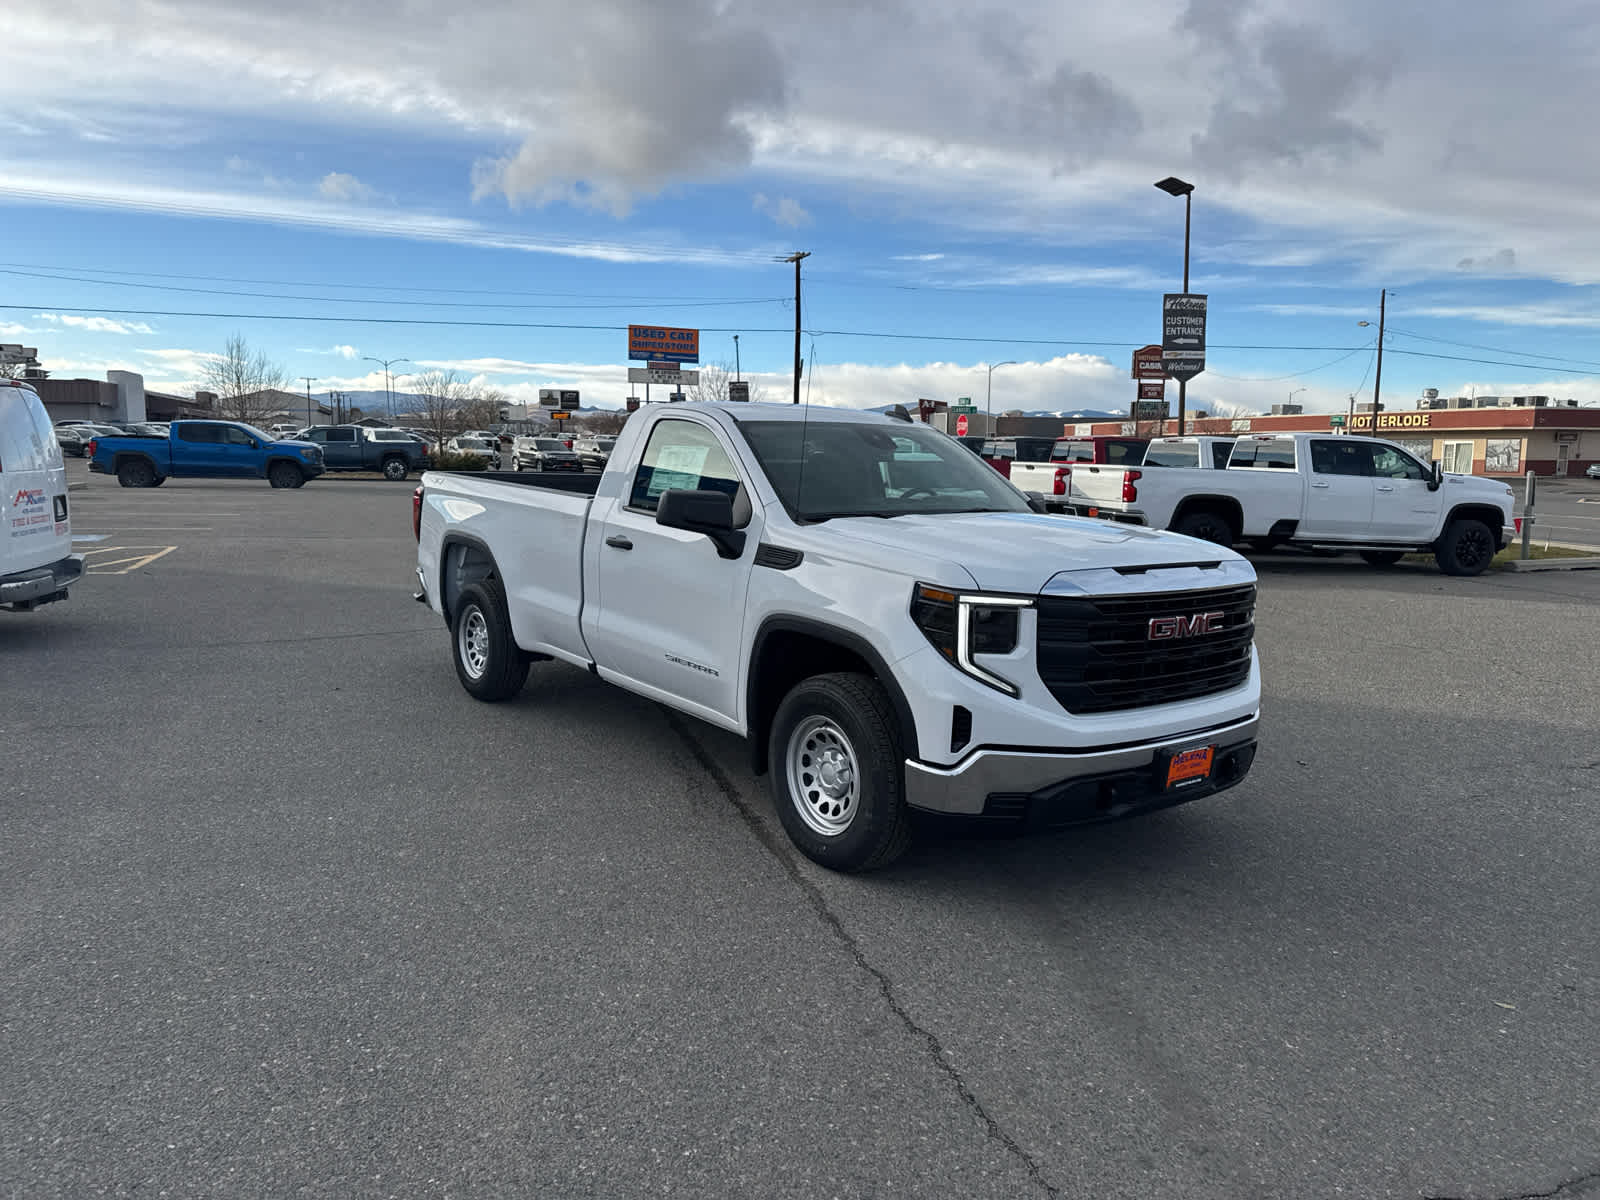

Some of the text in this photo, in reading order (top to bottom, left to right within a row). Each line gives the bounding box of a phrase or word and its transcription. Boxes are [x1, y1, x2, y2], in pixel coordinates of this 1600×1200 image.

[1166, 316, 1204, 326] CUSTOMER
[633, 327, 694, 341] USED CAR
[1166, 327, 1203, 336] ENTRANCE
[631, 340, 696, 351] SUPERSTORE
[1139, 361, 1162, 370] CASIN
[1148, 611, 1225, 641] GMC
[664, 653, 720, 677] SIERRA
